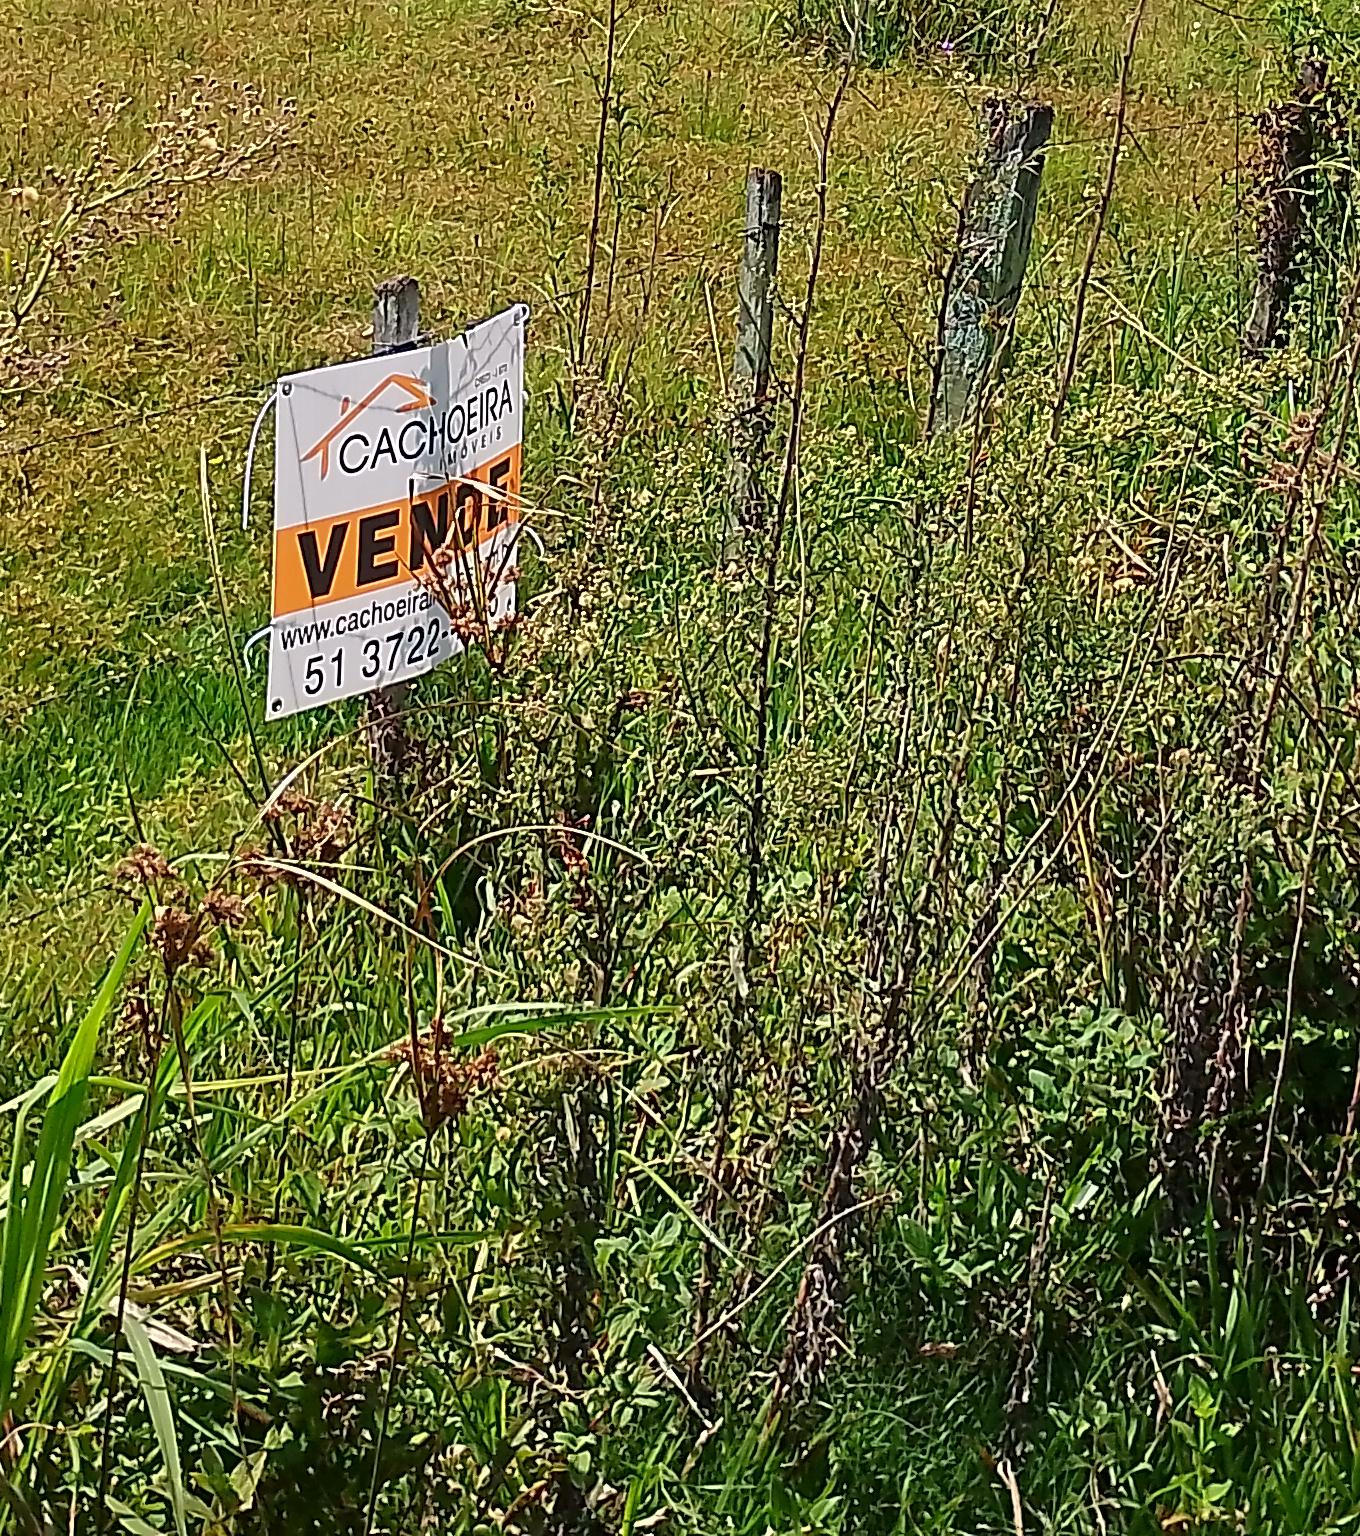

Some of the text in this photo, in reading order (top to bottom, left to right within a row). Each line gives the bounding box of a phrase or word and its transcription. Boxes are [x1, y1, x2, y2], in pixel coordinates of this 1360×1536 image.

[339, 378, 513, 474] CACHOEIRA
[297, 456, 511, 599] VENDE
[305, 650, 342, 695] 51
